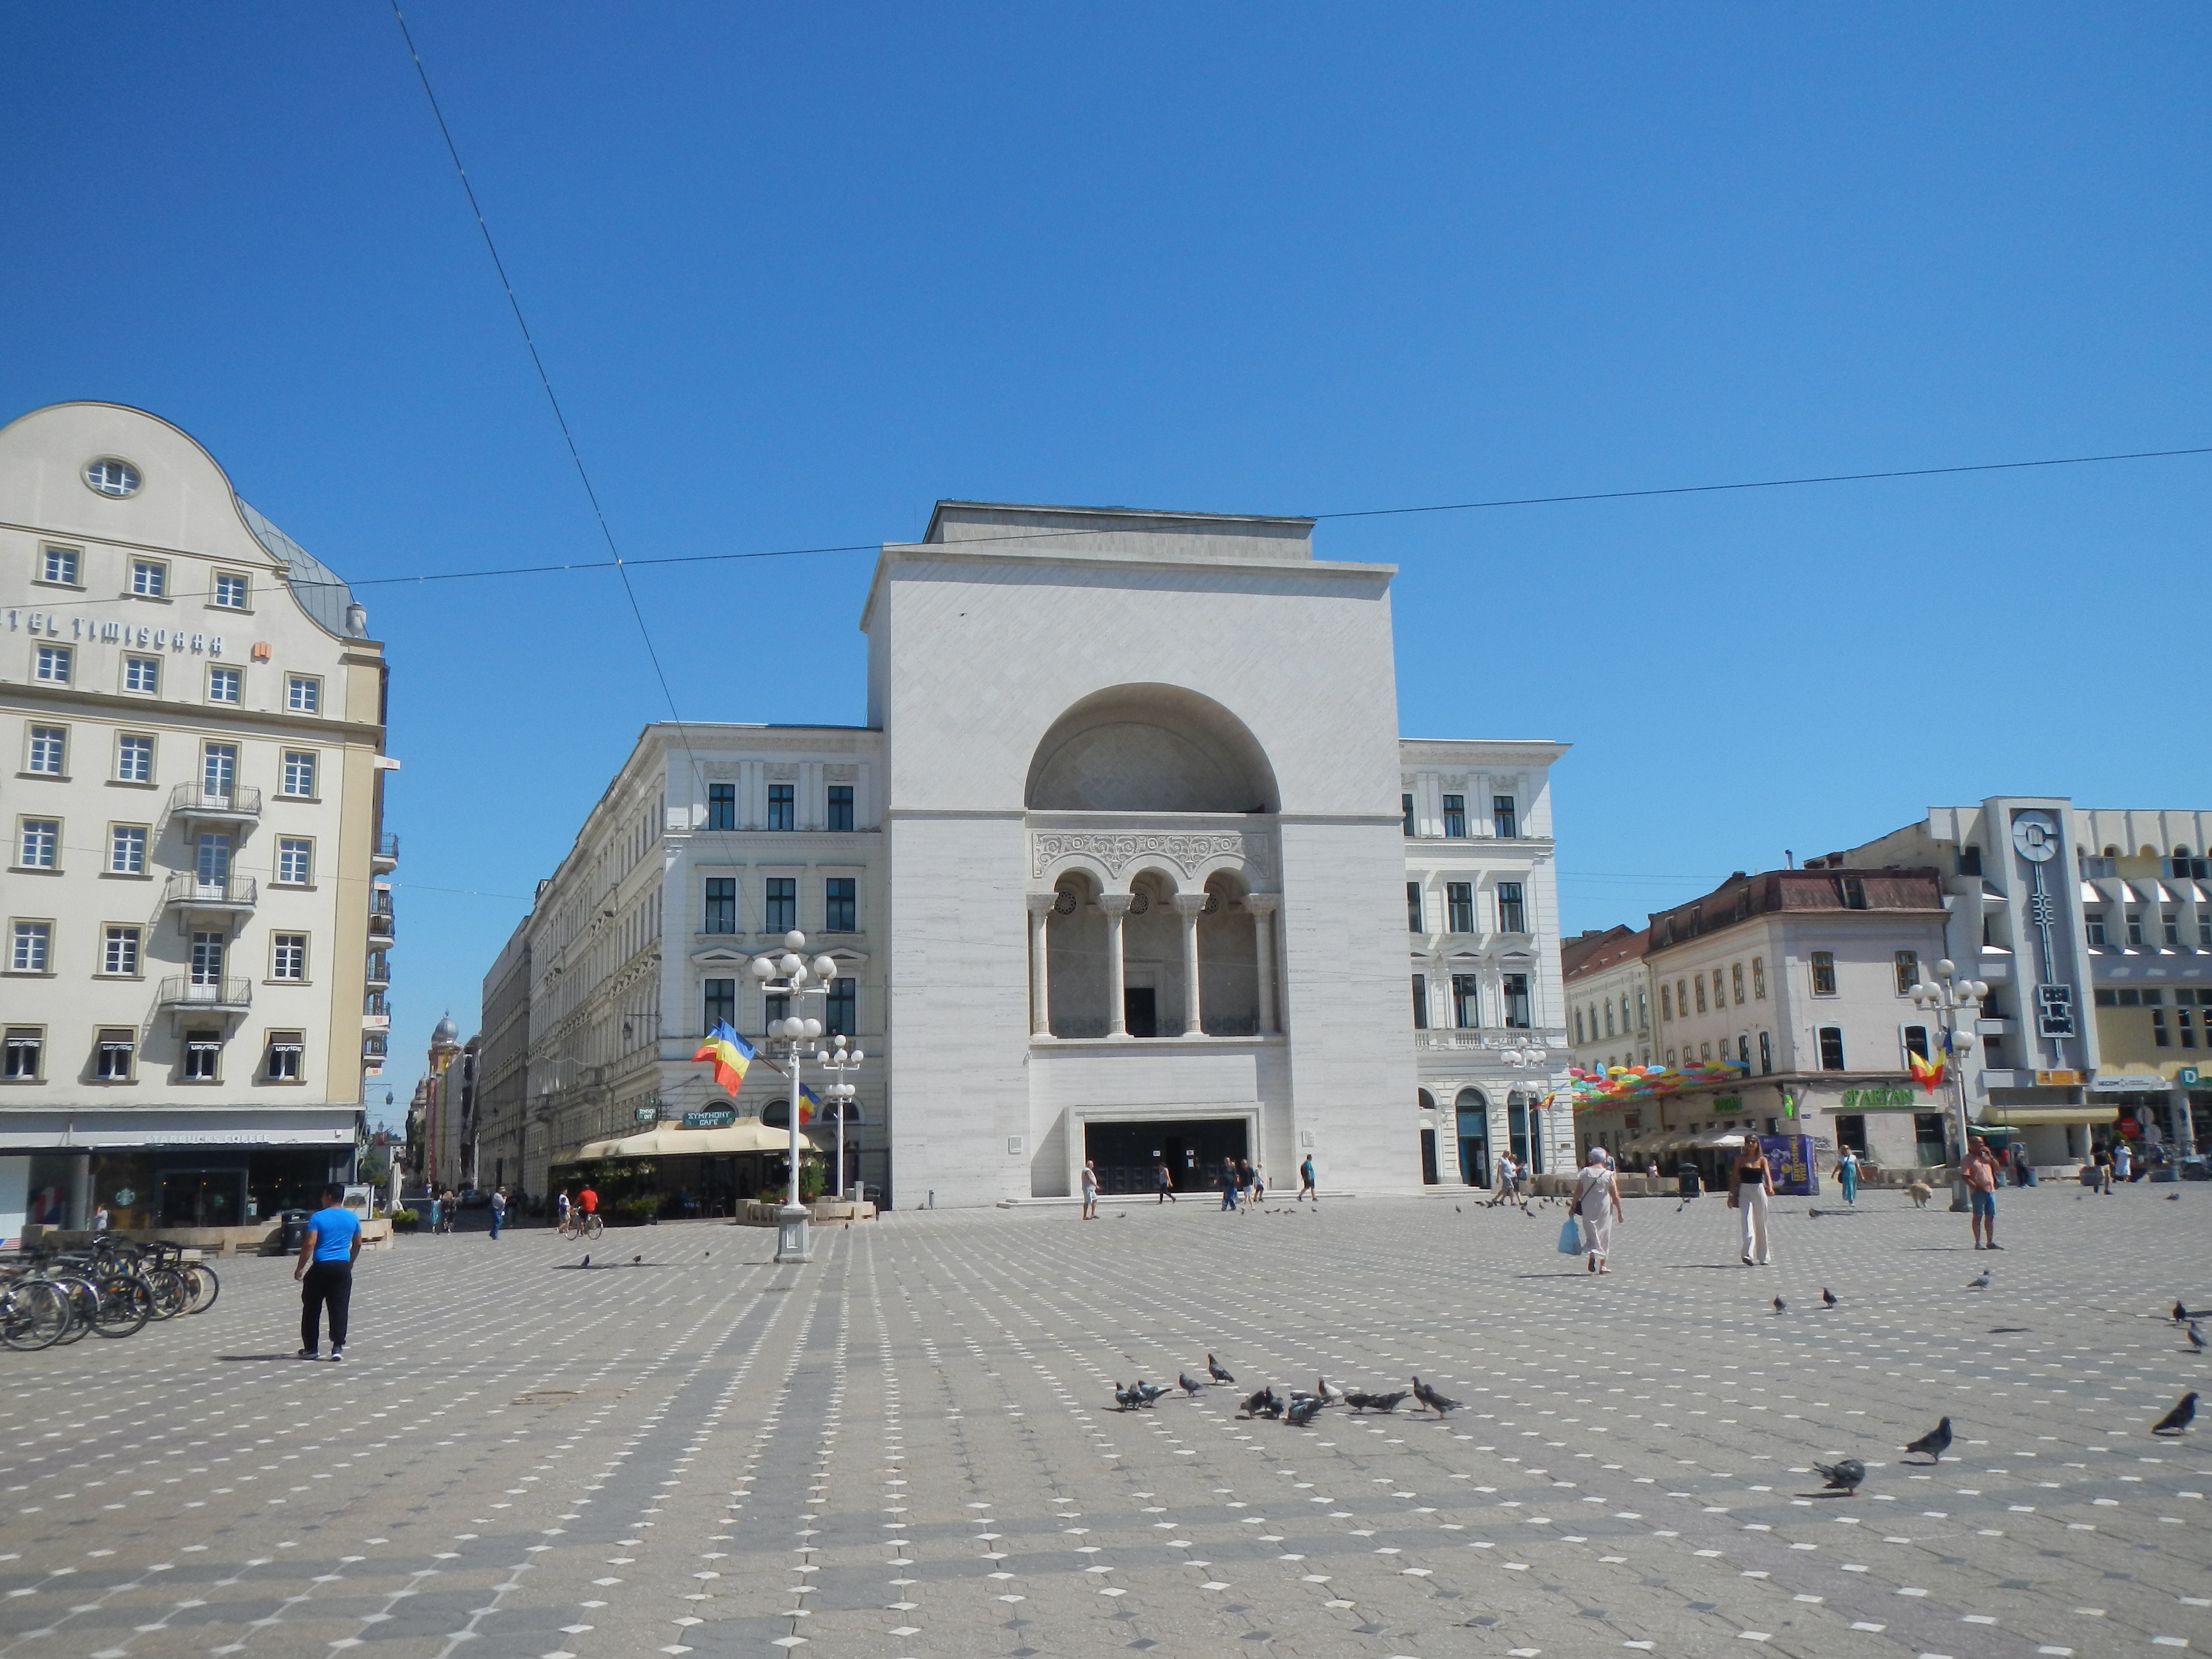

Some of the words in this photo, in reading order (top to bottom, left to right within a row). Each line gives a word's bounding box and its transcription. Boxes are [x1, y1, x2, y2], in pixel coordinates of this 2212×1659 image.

[1844, 1088, 1915, 1105] SPARTAN
[688, 1111, 730, 1119] SYMPHONY
[145, 1135, 220, 1143] STARBUCKS
[224, 1134, 270, 1143] COFFEE
